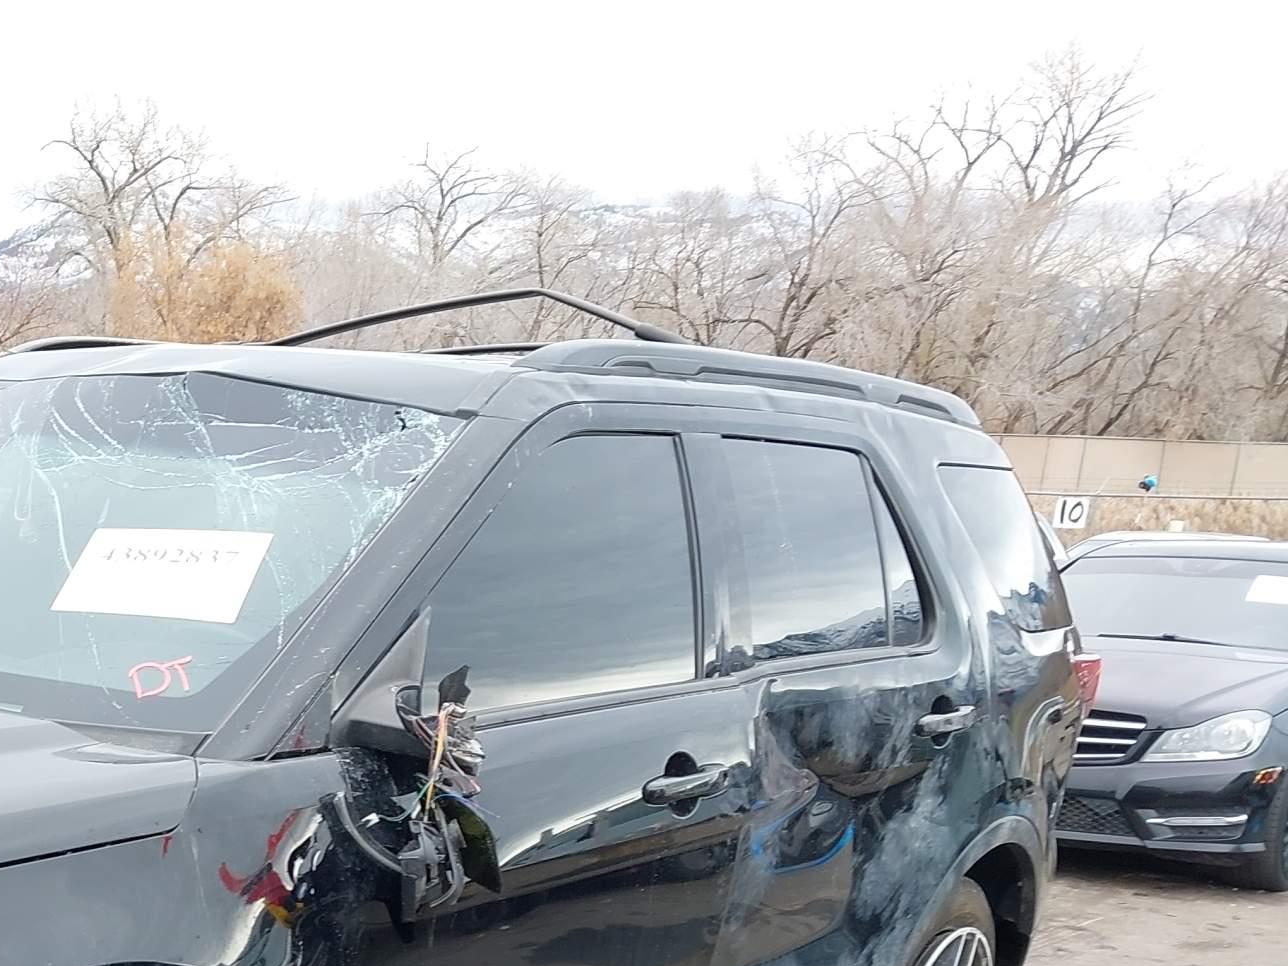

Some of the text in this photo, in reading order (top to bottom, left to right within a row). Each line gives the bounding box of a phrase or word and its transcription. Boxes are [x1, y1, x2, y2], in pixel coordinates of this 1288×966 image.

[1060, 499, 1084, 524] 10
[100, 547, 240, 563] 43892837
[128, 655, 193, 699] DT
